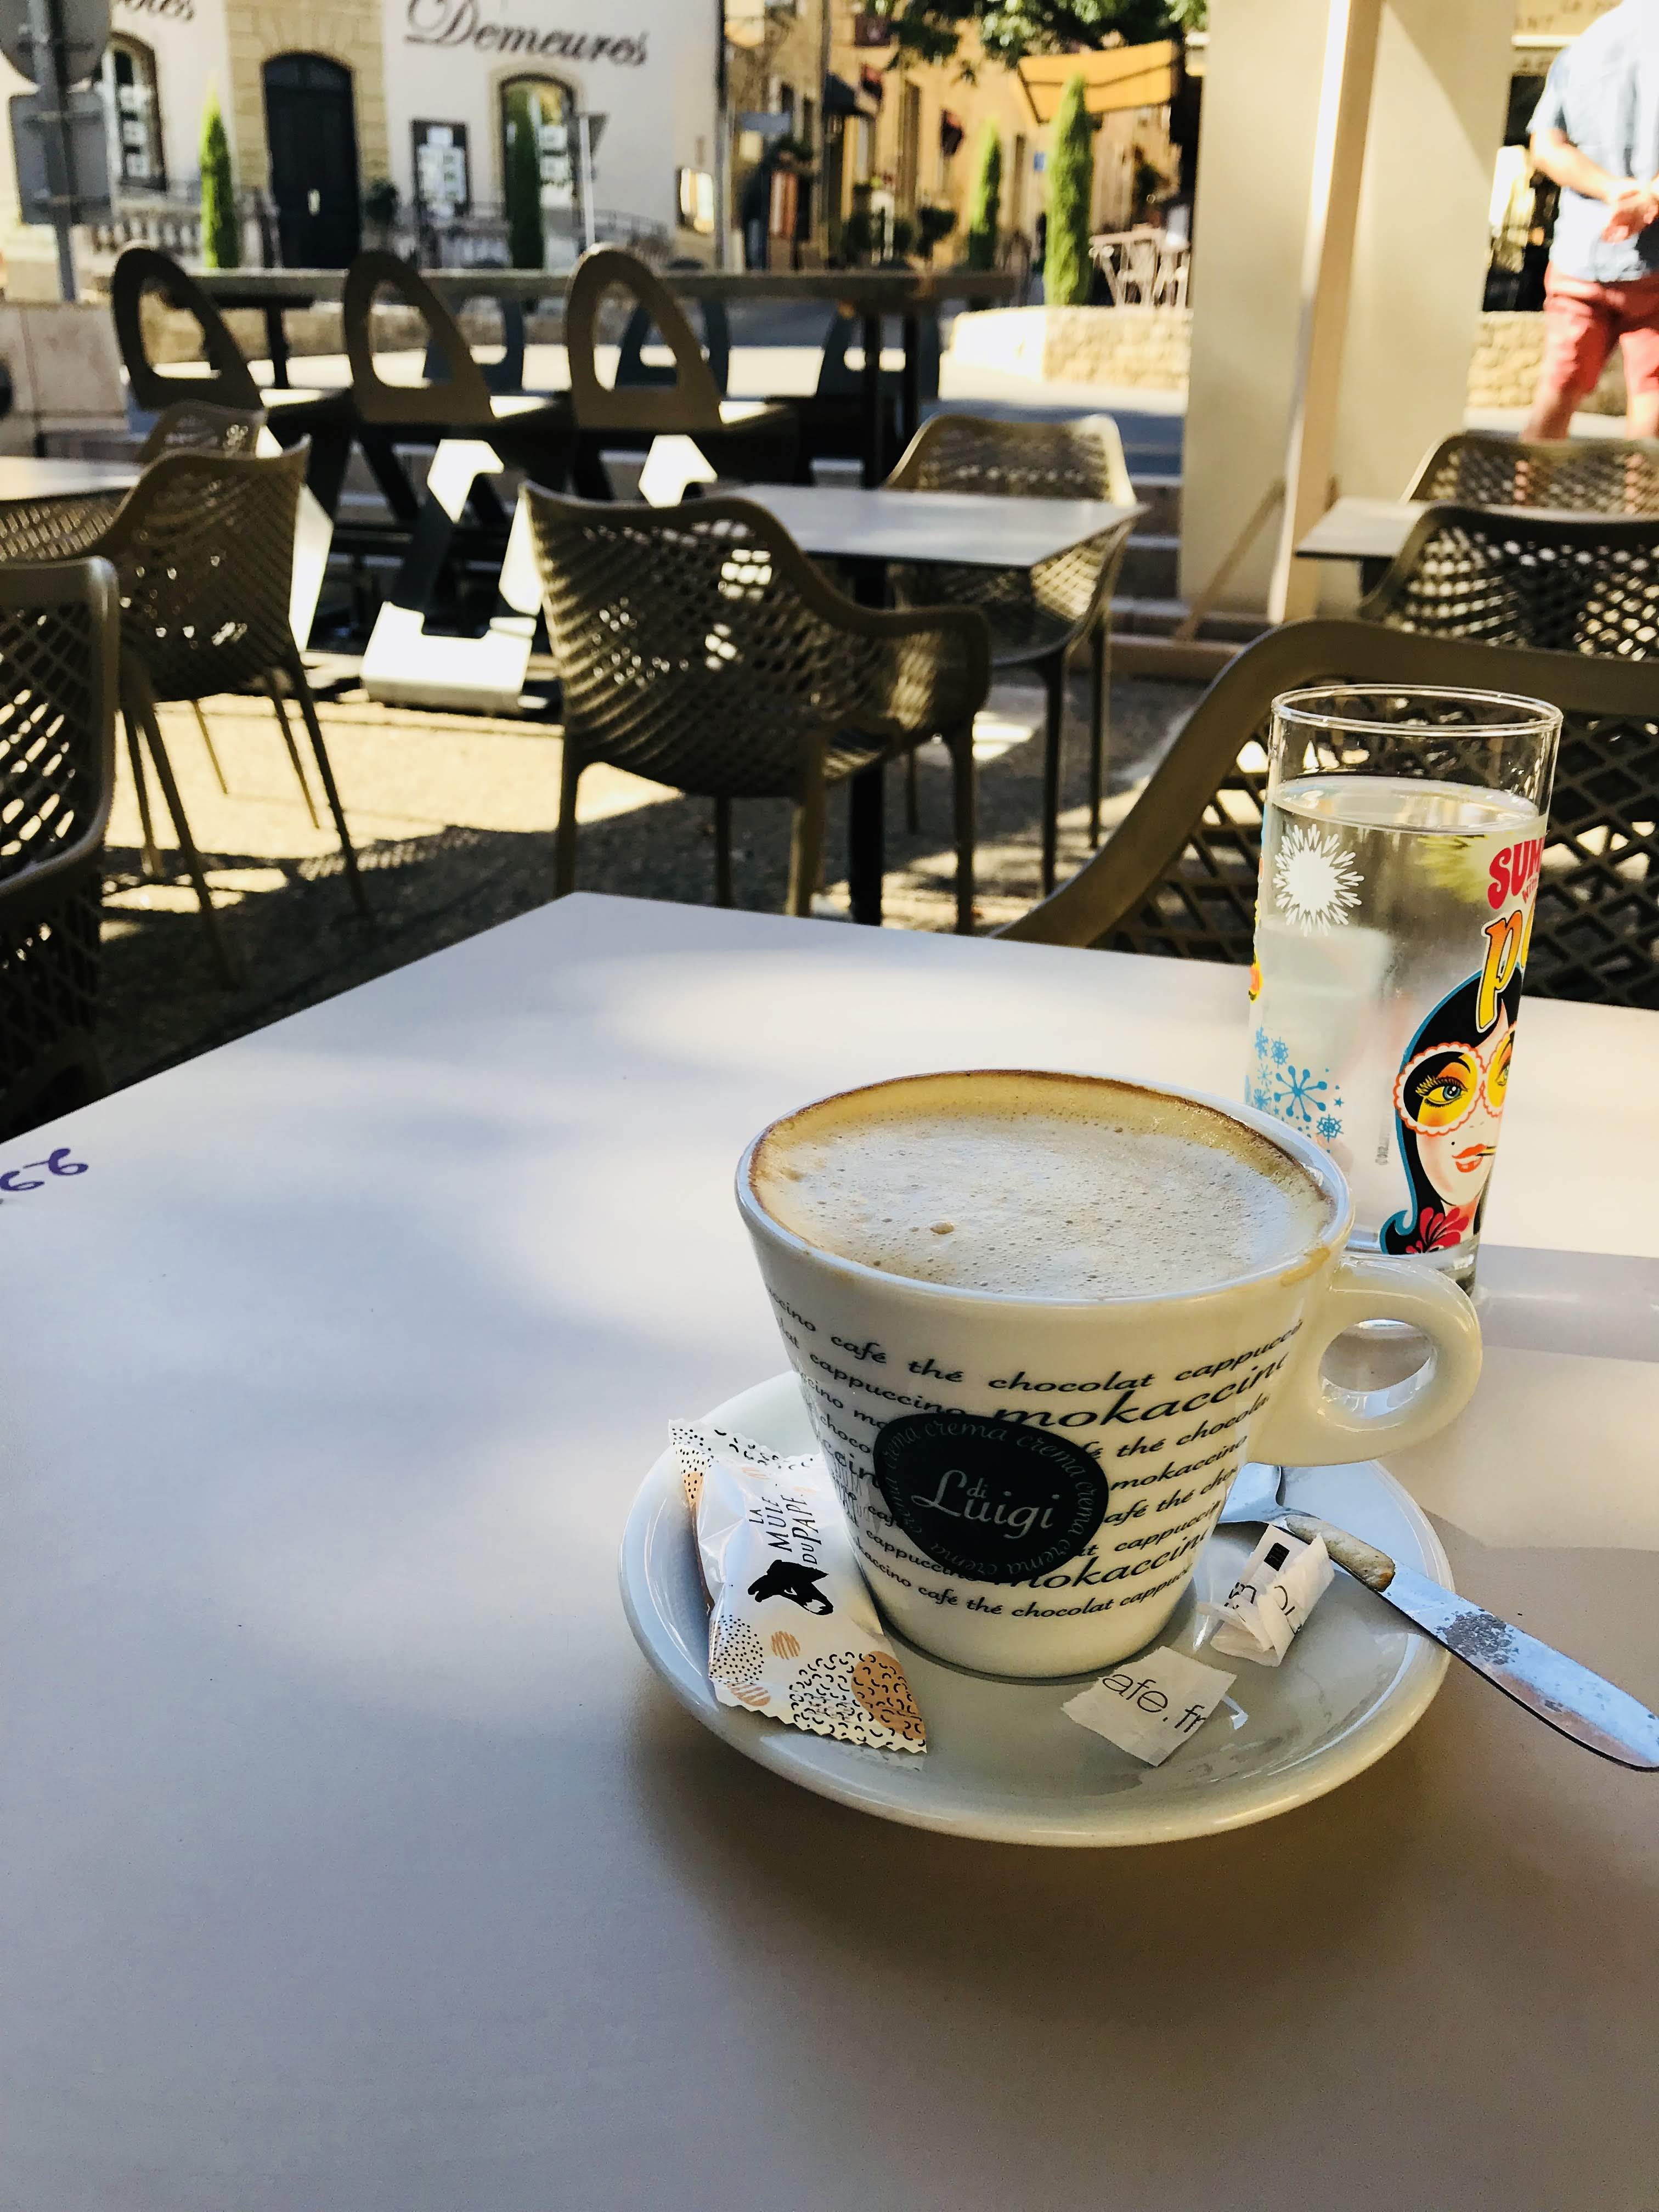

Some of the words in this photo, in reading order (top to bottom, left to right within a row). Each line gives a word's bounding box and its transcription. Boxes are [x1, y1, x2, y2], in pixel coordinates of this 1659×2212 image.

[768, 1288, 816, 1331] ccino
[830, 1336, 887, 1364] café
[908, 1358, 964, 1383] thé
[988, 1370, 1155, 1392] chocolat
[924, 1420, 1008, 1442] crema
[1116, 1436, 1167, 1458] thé
[820, 1413, 872, 1454] choco
[1110, 1435, 1248, 1491] mokaccino
[1016, 1435, 1086, 1478] crema
[910, 1469, 1060, 1539] Luigi
[966, 1477, 988, 1499] di
[748, 1509, 764, 1524] LA
[761, 1497, 793, 1553] MULE
[1068, 1481, 1098, 1536] crema
[1104, 1499, 1149, 1526] afé
[1156, 1489, 1197, 1513] thé
[930, 1542, 998, 1576] crema
[1006, 1538, 1071, 1575] crema
[918, 1589, 958, 1605] café
[966, 1596, 1003, 1615] thé
[1011, 1597, 1116, 1617] chocolat
